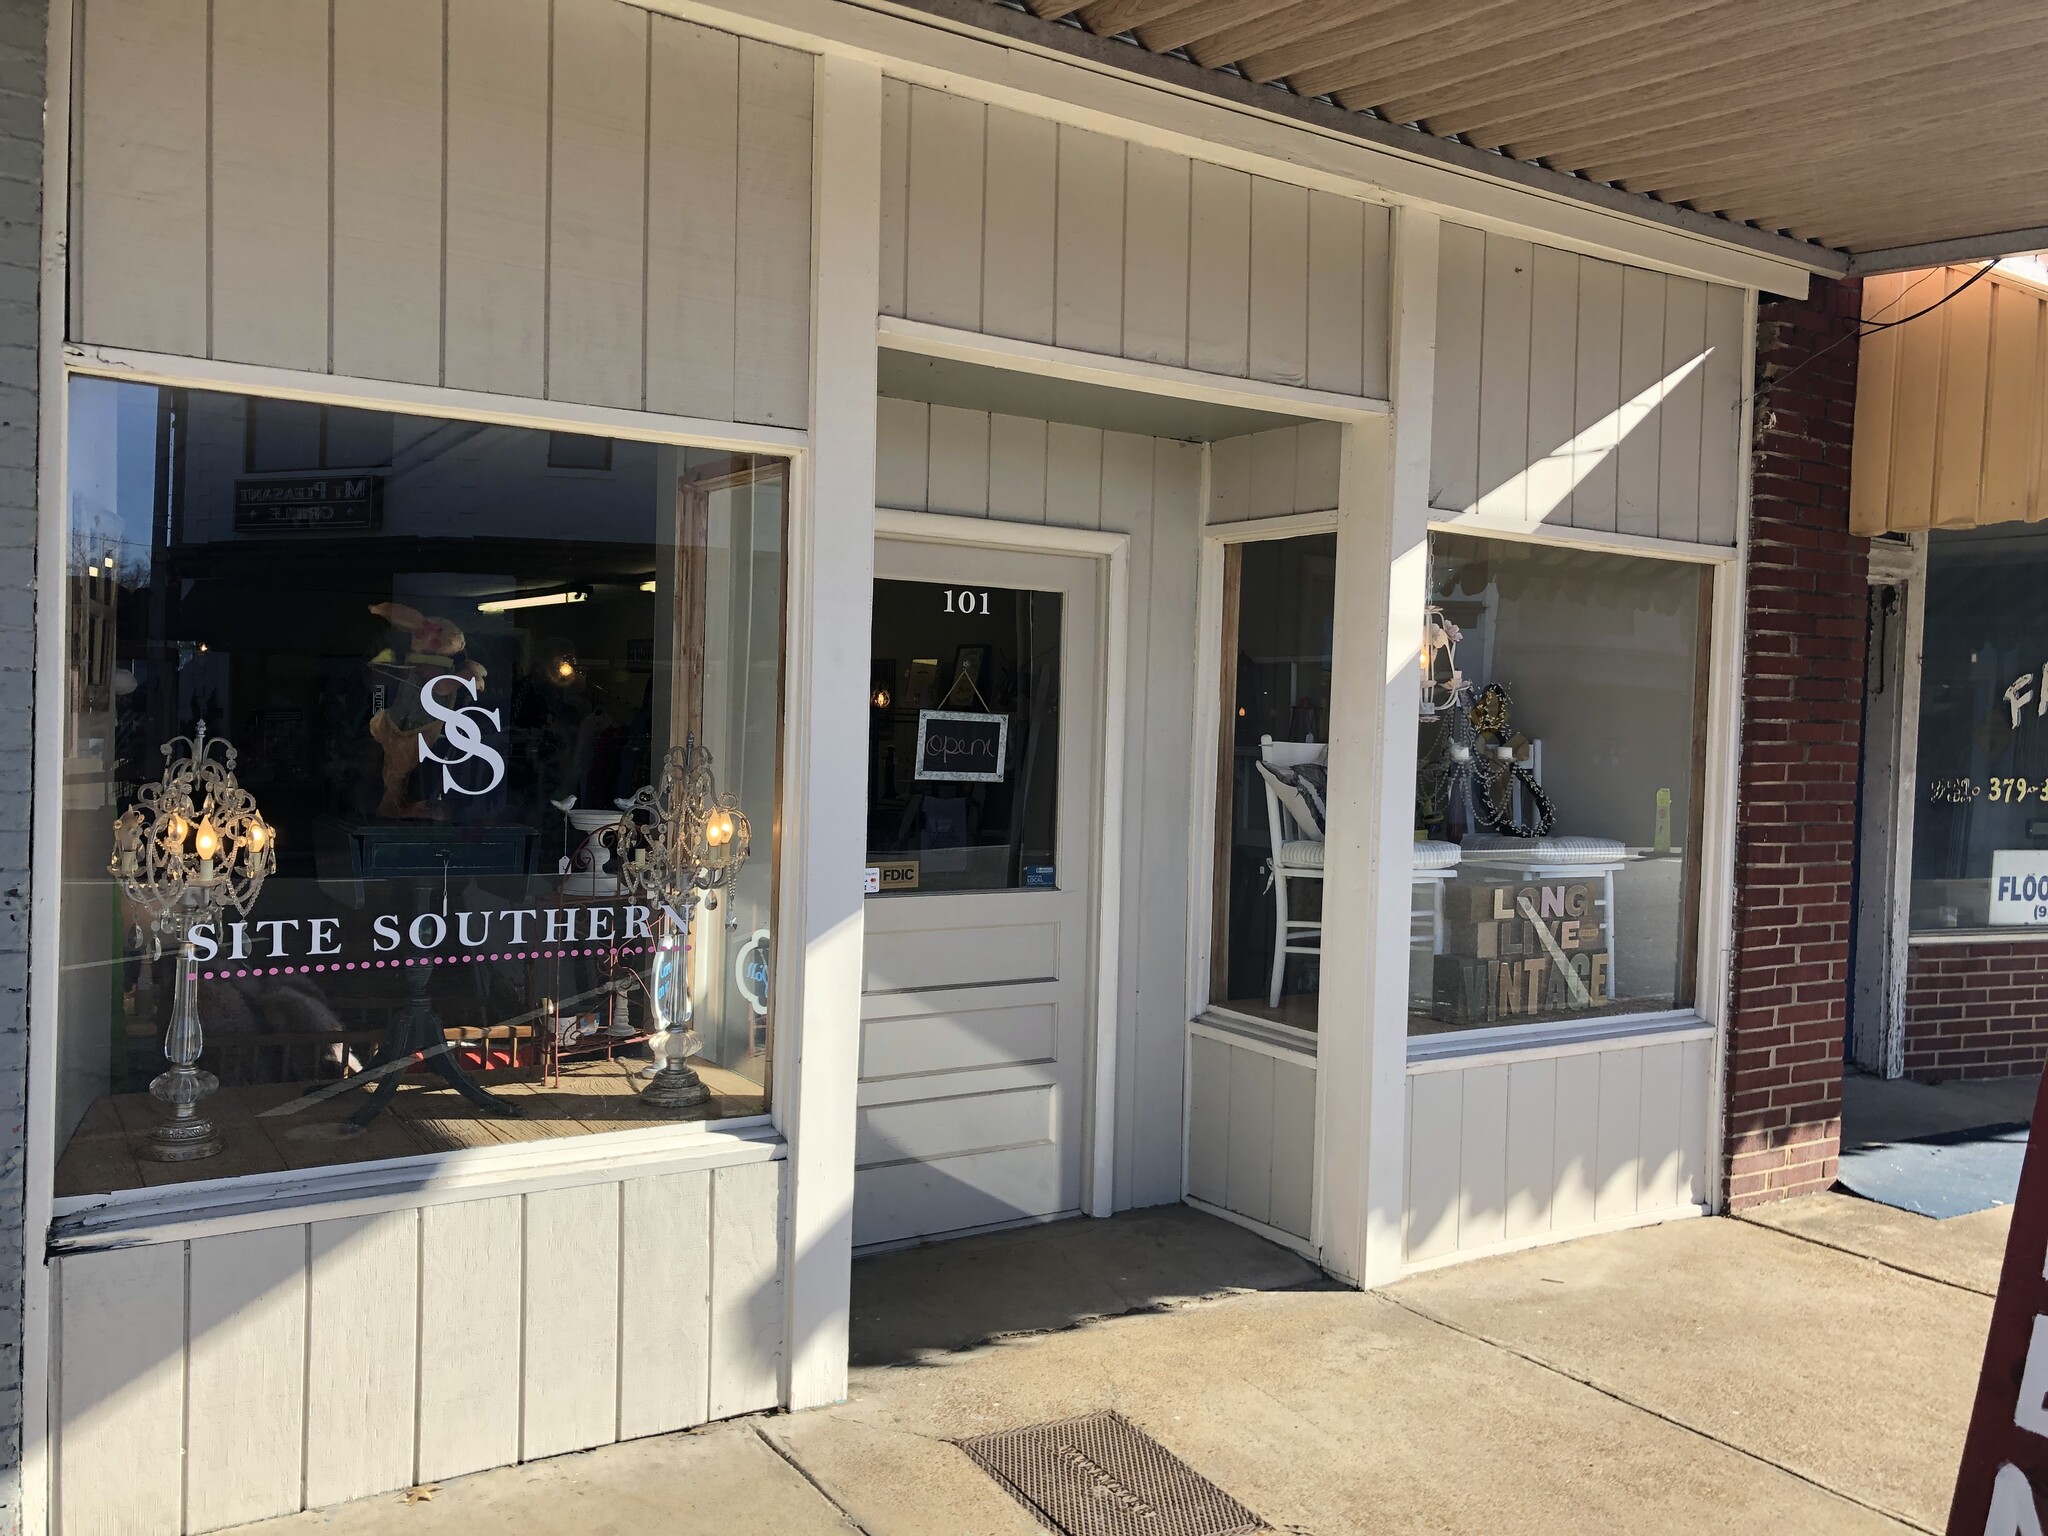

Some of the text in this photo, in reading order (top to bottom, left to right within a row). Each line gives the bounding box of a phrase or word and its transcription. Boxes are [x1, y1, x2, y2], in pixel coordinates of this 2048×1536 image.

[943, 589, 990, 615] 101
[883, 868, 914, 882] FDIC
[1494, 885, 1588, 919] LONG
[187, 903, 692, 962] SITE SOUTHERN
[1501, 920, 1580, 955] LIVE
